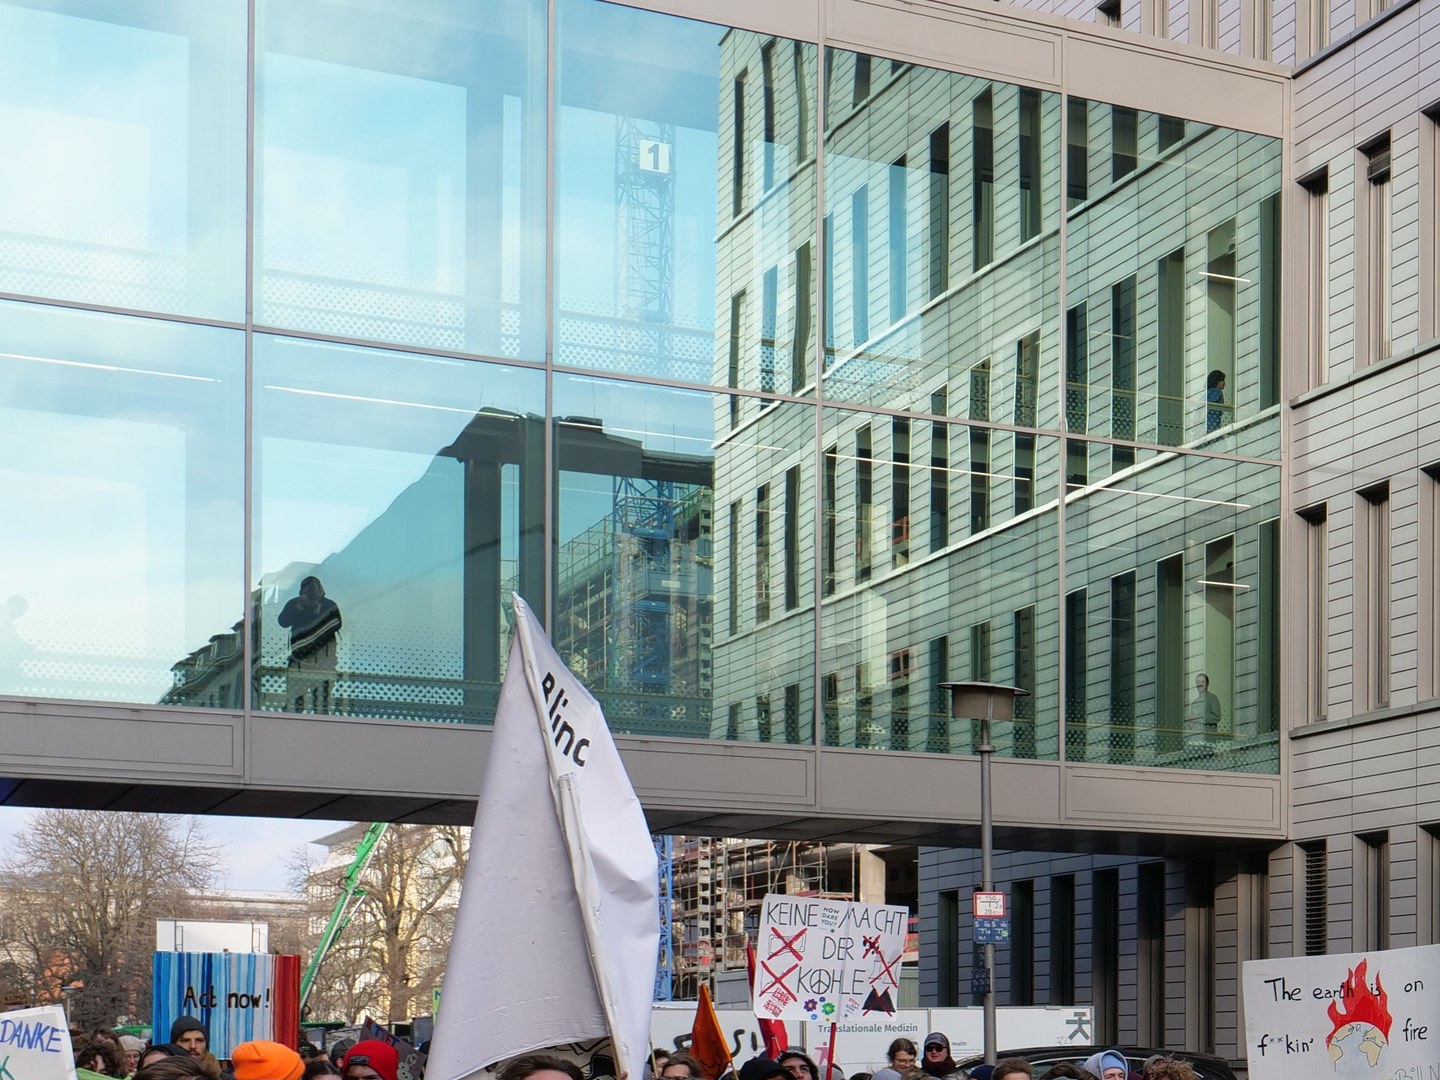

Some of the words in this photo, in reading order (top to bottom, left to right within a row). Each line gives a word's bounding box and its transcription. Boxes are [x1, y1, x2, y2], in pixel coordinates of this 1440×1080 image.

[648, 143, 660, 170] 1
[766, 901, 819, 927] KEINE
[838, 907, 907, 936] MACHT
[820, 919, 838, 927] YOU?
[821, 912, 839, 920] DARE
[822, 936, 855, 961] DER
[796, 966, 867, 996] KOHLE
[1264, 977, 1302, 1001] The
[1312, 979, 1355, 1000] earth
[1370, 983, 1381, 997] is
[1404, 980, 1424, 993] on
[183, 986, 217, 1008] Act
[227, 988, 270, 1008] now!
[0, 1019, 66, 1053] DANKE
[884, 1023, 918, 1033] Medizin
[1402, 1018, 1428, 1042] fire
